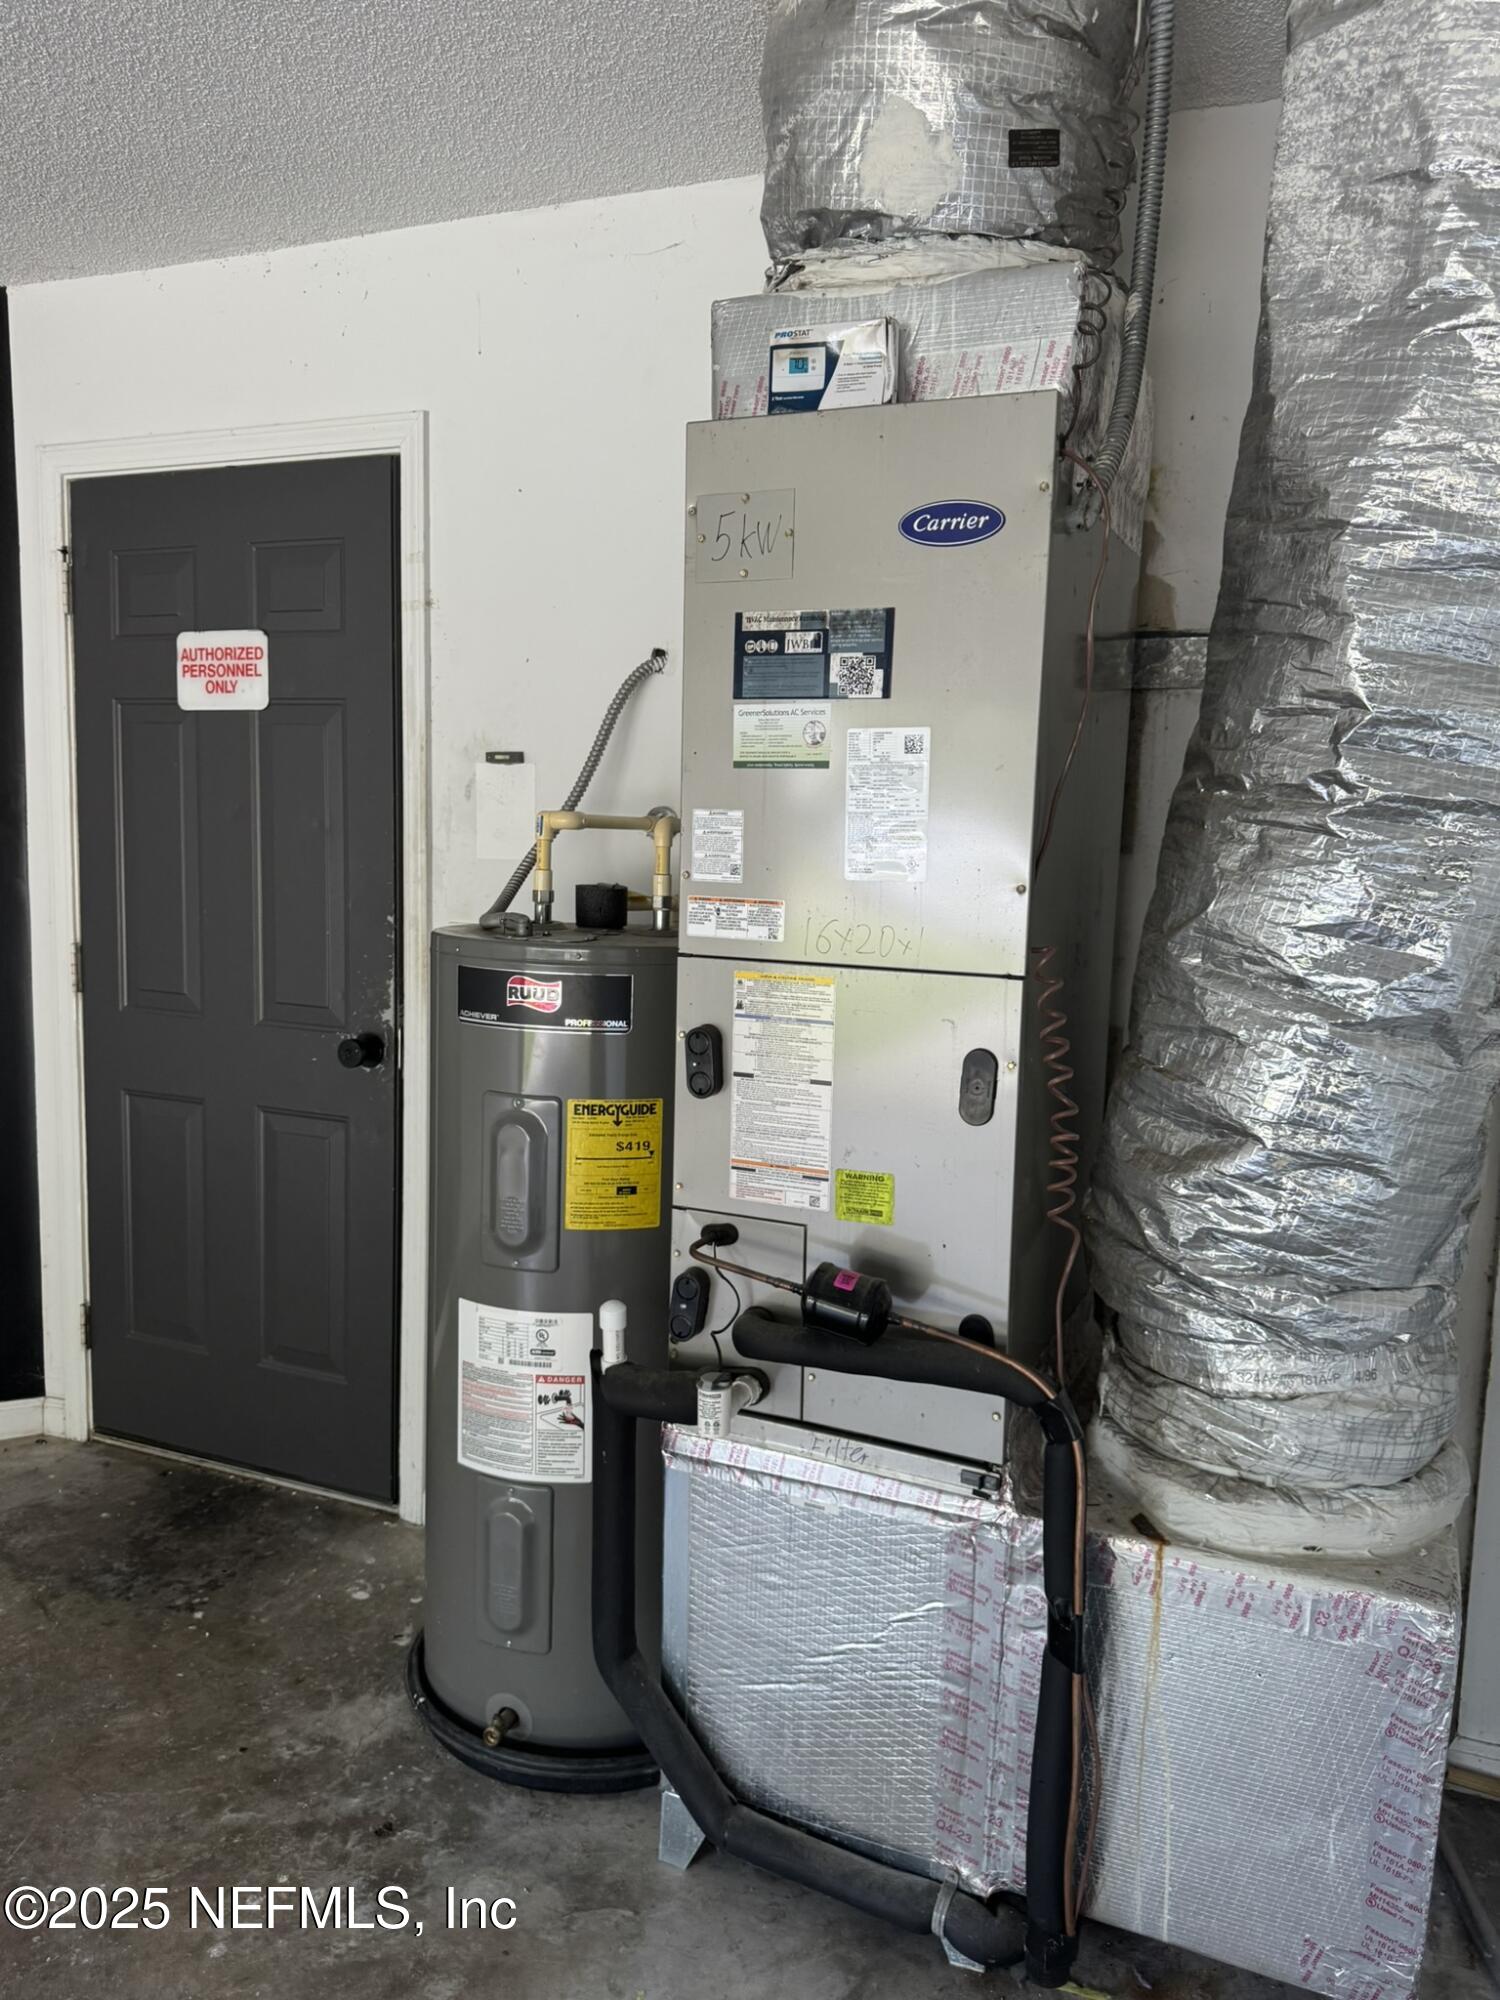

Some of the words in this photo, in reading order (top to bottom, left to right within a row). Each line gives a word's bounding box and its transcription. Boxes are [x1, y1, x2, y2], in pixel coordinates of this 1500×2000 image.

[775, 329, 810, 338] PROSTAT
[913, 510, 990, 532] Carrier
[786, 638, 810, 651] JWB
[180, 646, 264, 662] AUTHORIZED
[182, 664, 262, 678] PERSONNEL
[205, 680, 238, 694] ONLY
[801, 708, 826, 716] Services
[508, 986, 560, 1000] RUUD
[574, 1104, 657, 1116] ENERGYGUIDE
[845, 1172, 885, 1182] WARNING
[810, 1437, 870, 1463] Filter
[936, 1820, 972, 1844] Q4-23
[1372, 1850, 1383, 1859] UL
[1373, 1840, 1404, 1860] Fasson
[1408, 1858, 1426, 1871] 0800
[1369, 1858, 1380, 1867] UL
[1364, 1934, 1374, 1944] UL
[1361, 1941, 1371, 1951] UL
